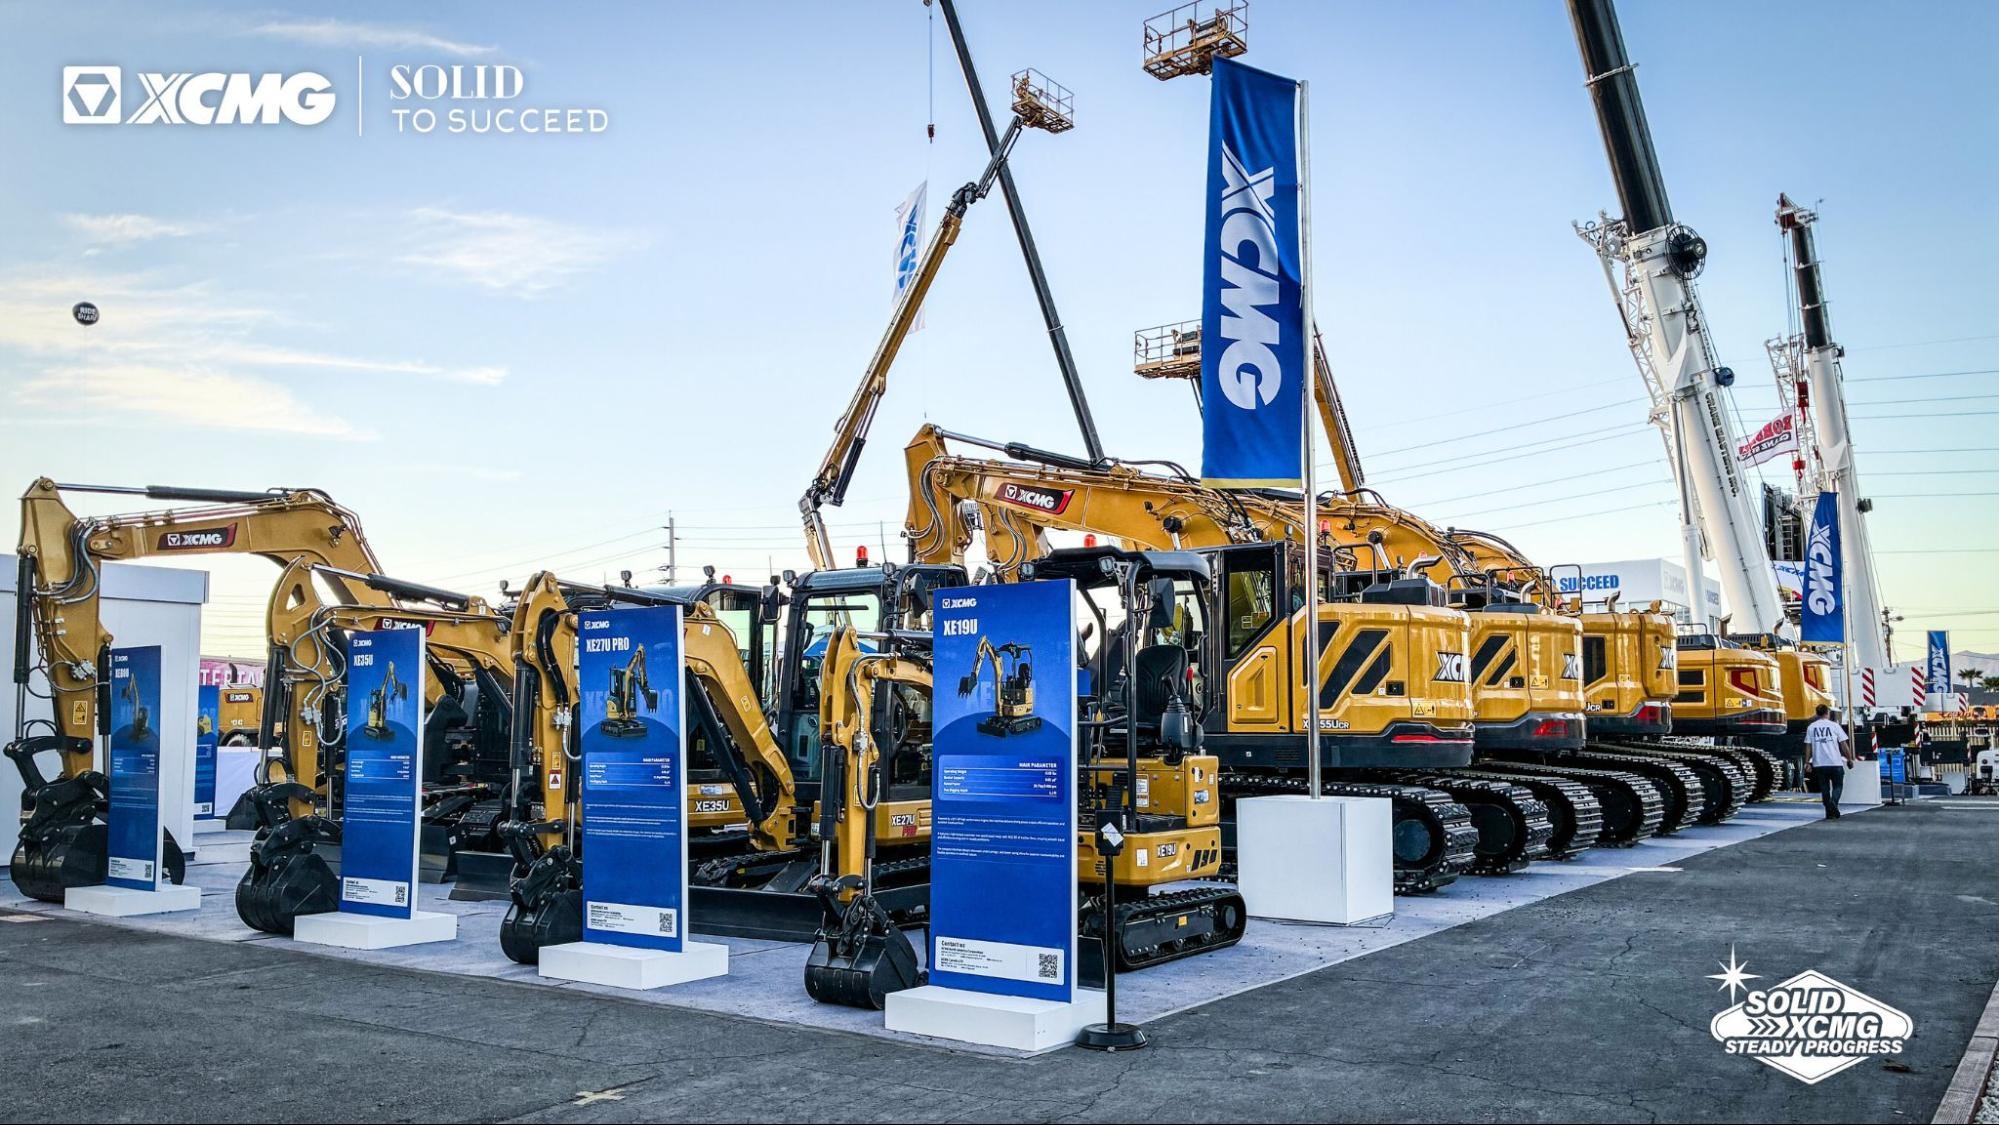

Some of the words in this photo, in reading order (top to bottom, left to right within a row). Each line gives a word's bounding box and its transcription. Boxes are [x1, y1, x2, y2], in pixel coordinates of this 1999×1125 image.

[1218, 139, 1282, 409] XCMG
[1017, 488, 1055, 508] XCMG
[181, 533, 222, 546] XCMG
[1808, 519, 1836, 616] XCMG
[1560, 574, 1619, 591] SUCCEED
[951, 598, 977, 608] XCMG
[591, 621, 610, 629] XCMG
[943, 619, 978, 636] XE19U
[586, 638, 611, 653] XE27U
[612, 637, 630, 651] PRO
[353, 654, 374, 667] XE35U
[695, 800, 730, 812] XE35U
[891, 814, 915, 826] XE27U
